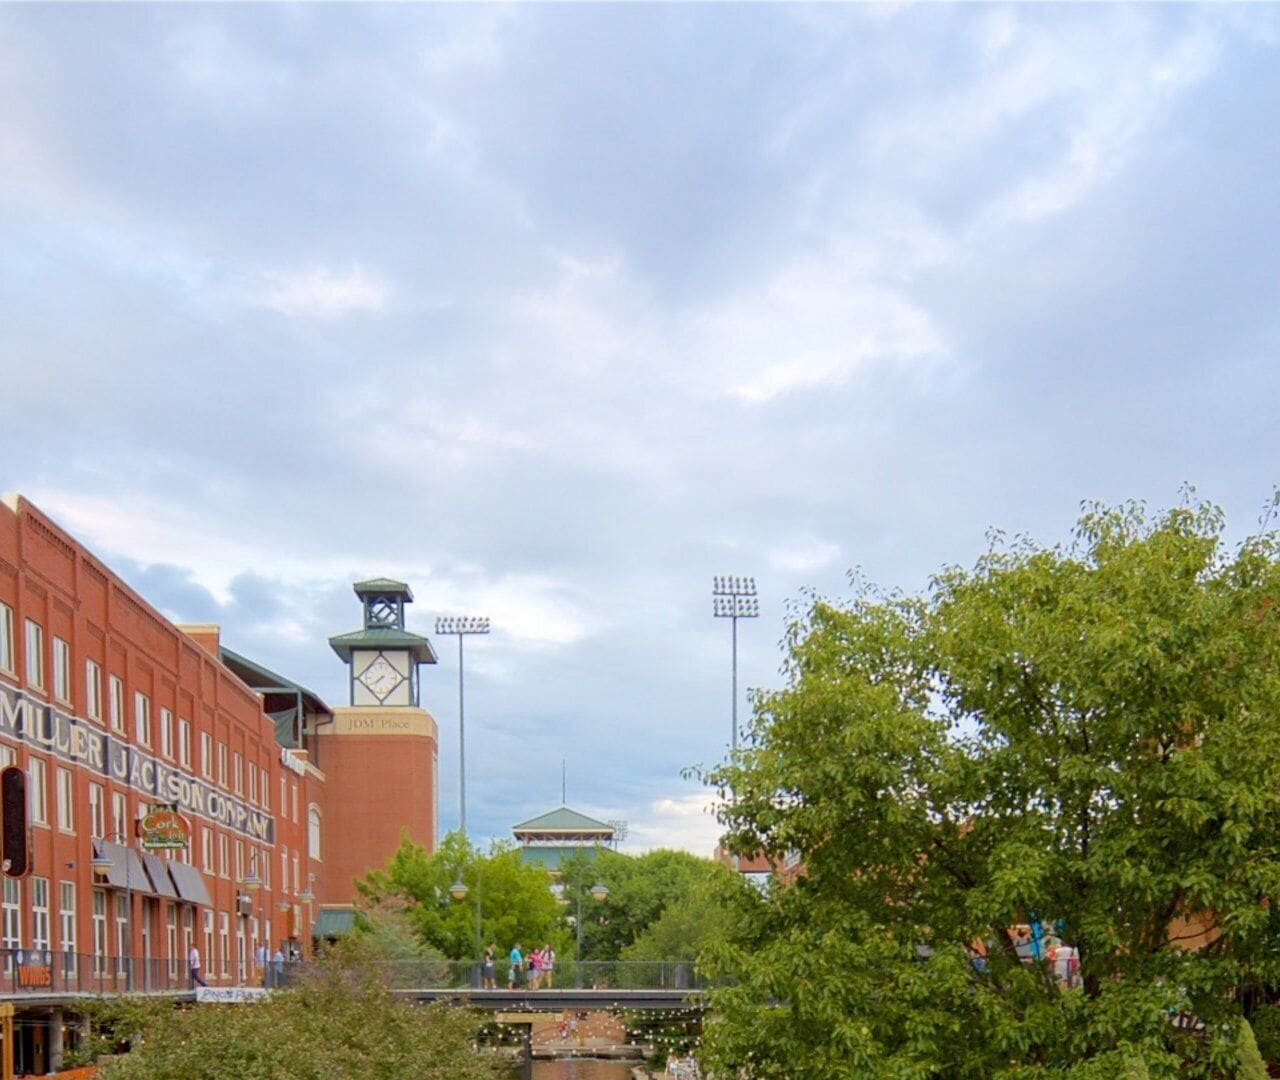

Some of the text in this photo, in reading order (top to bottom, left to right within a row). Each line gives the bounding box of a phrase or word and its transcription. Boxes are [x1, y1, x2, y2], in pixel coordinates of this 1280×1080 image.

[349, 719, 409, 730] JDM Place
[113, 750, 205, 810] JACKSON
[207, 790, 269, 840] COMPANY
[142, 815, 180, 832] Cork
[18, 966, 51, 986] WINGS
